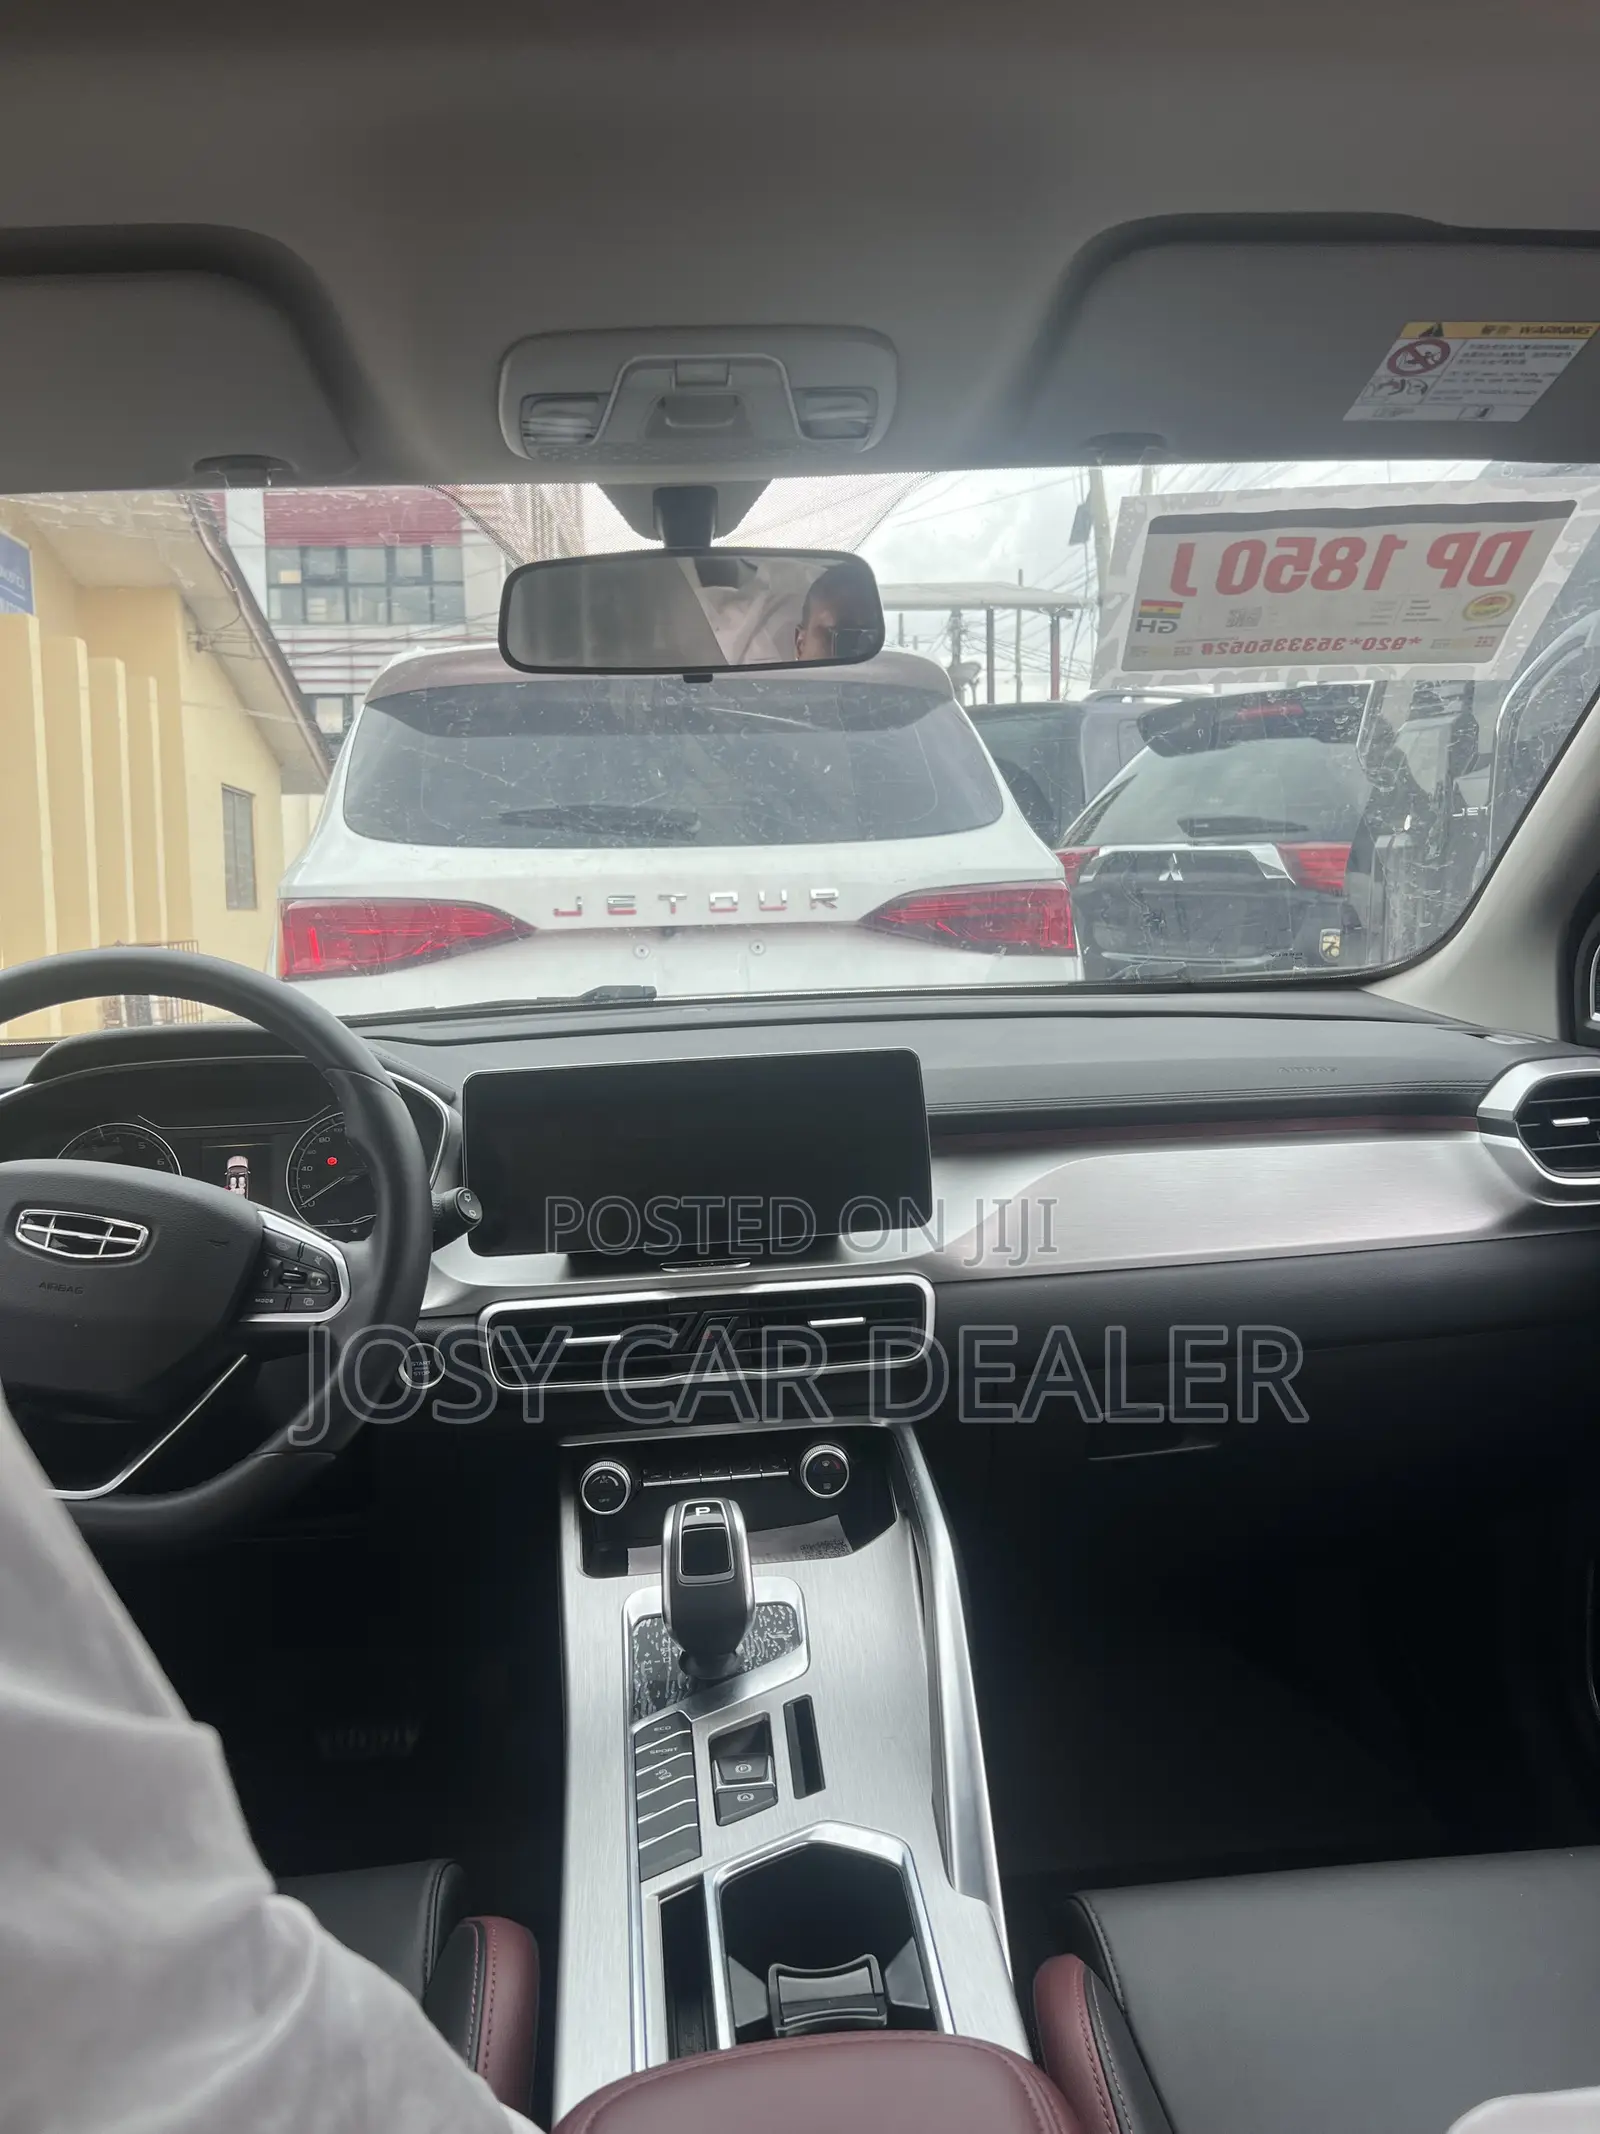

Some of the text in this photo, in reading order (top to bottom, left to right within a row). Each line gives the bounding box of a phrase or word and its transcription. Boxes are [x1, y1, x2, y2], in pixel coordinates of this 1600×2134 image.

[1519, 325, 1593, 334] WARNING
[553, 887, 839, 917] JETOUR
[138, 1141, 146, 1149] 5
[156, 1157, 165, 1166] 6
[38, 1280, 85, 1295] AIRBAG
[695, 1506, 711, 1517] P
[653, 1724, 672, 1732] ECO
[649, 1746, 679, 1755] SPORT
